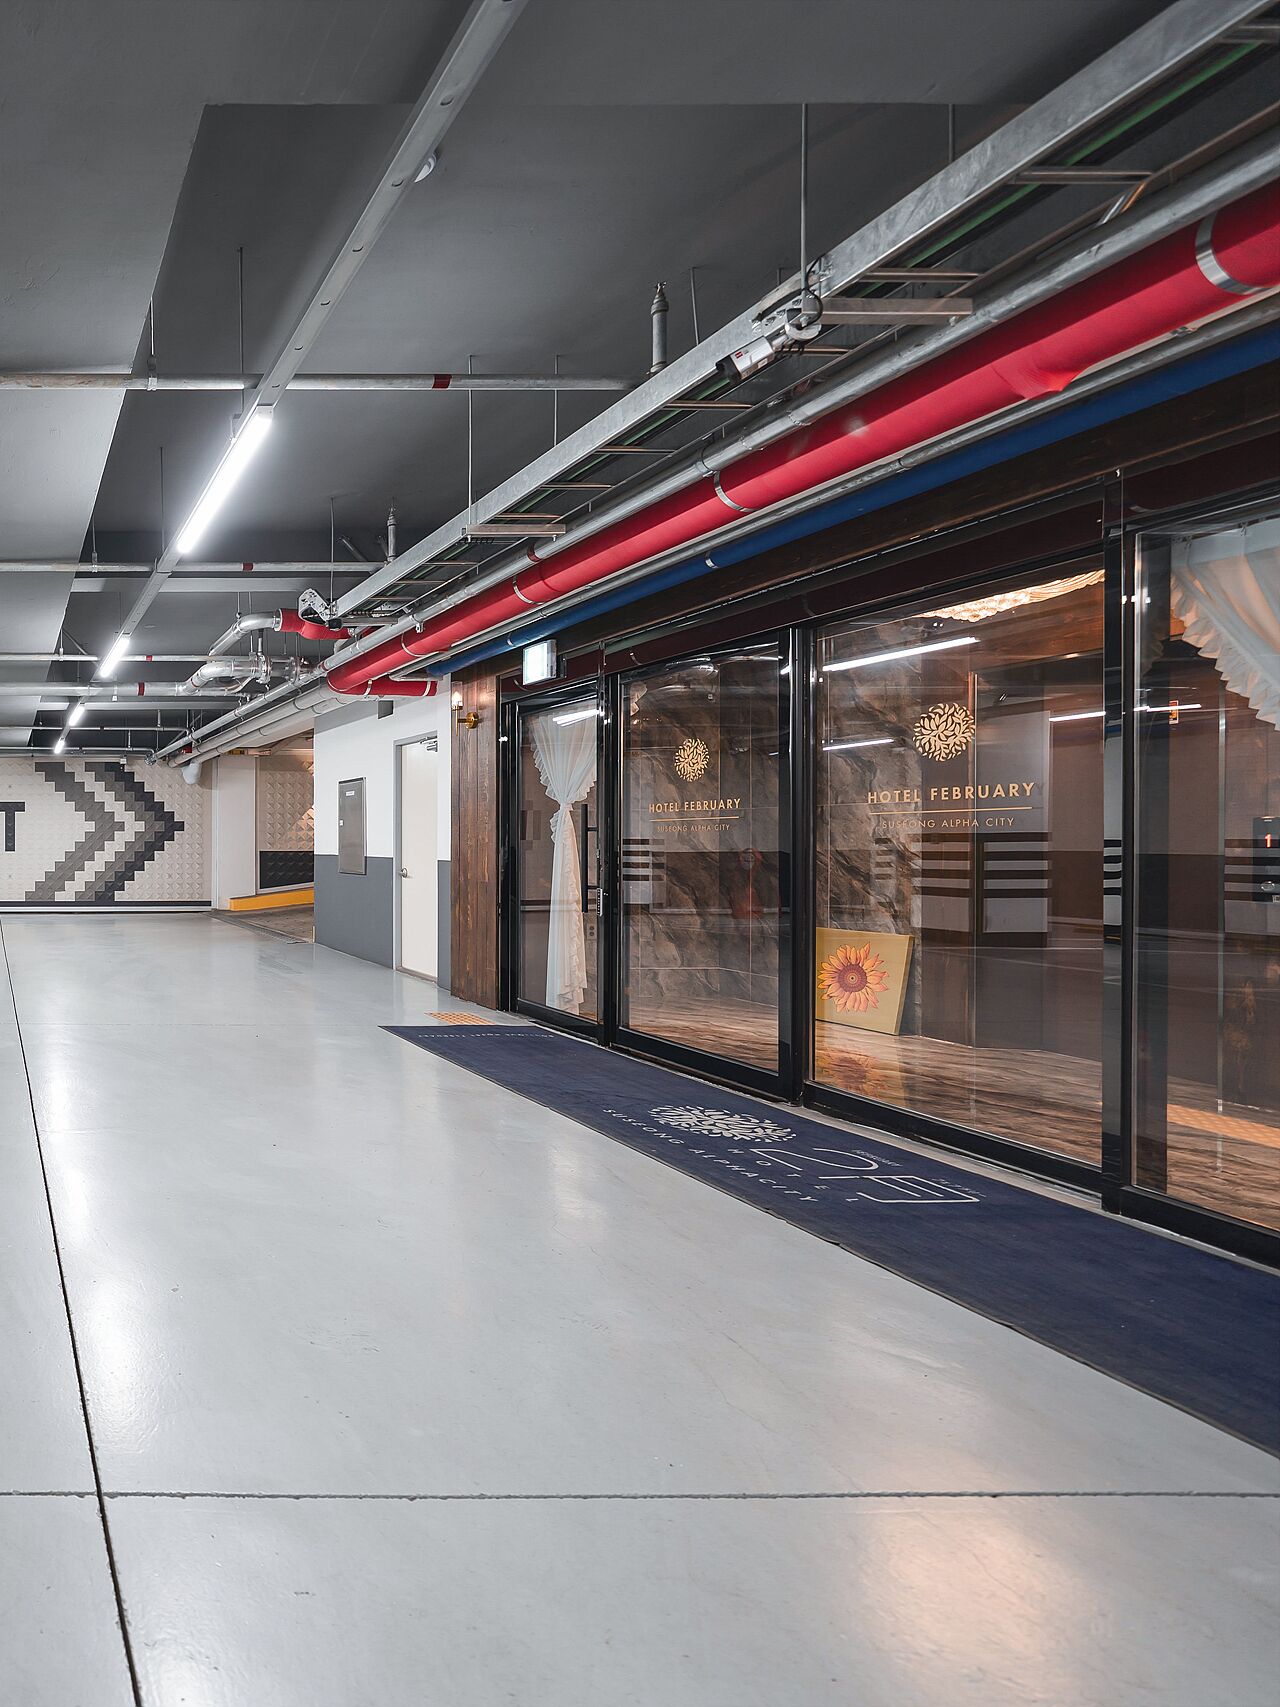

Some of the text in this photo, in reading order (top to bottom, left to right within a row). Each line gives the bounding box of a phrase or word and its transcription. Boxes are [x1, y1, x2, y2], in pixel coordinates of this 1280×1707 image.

[868, 782, 1035, 804] HOTEL FEBRUARY
[648, 798, 741, 813] HOTEL FEBRUARY
[690, 824, 711, 832] ALPHA
[714, 824, 730, 832] CITY
[882, 817, 1015, 829] SUSEONG ALPHA CITY
[602, 1108, 685, 1145] SUSEONG
